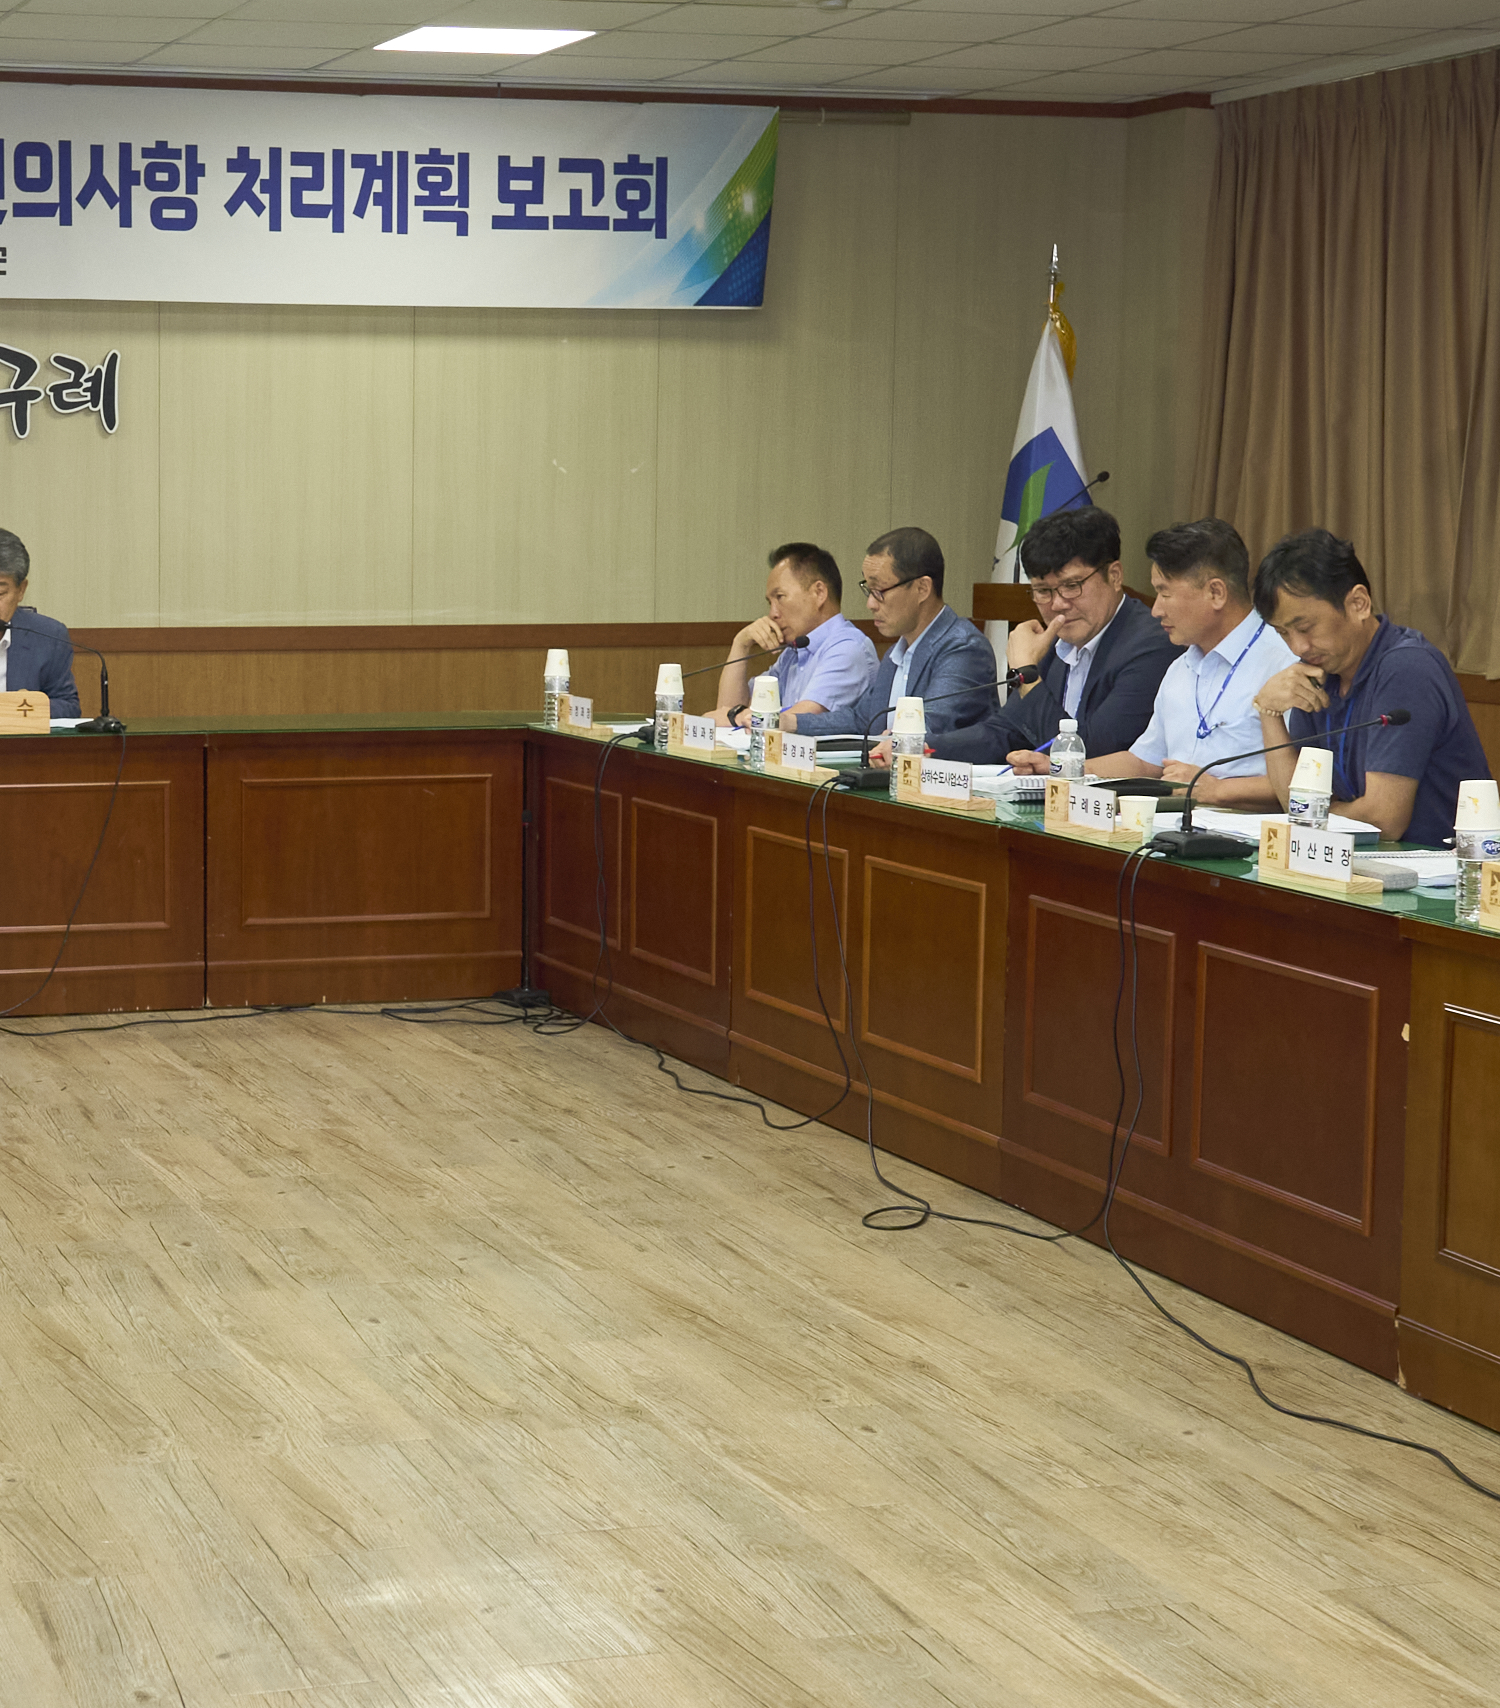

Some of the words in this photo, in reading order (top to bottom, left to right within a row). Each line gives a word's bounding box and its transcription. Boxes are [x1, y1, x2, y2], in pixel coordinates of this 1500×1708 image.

[223, 146, 471, 238] 처리계획
[491, 152, 669, 240] 보고회
[921, 769, 969, 789] 상하수도사업소장
[1291, 840, 1351, 867] 마산면장
